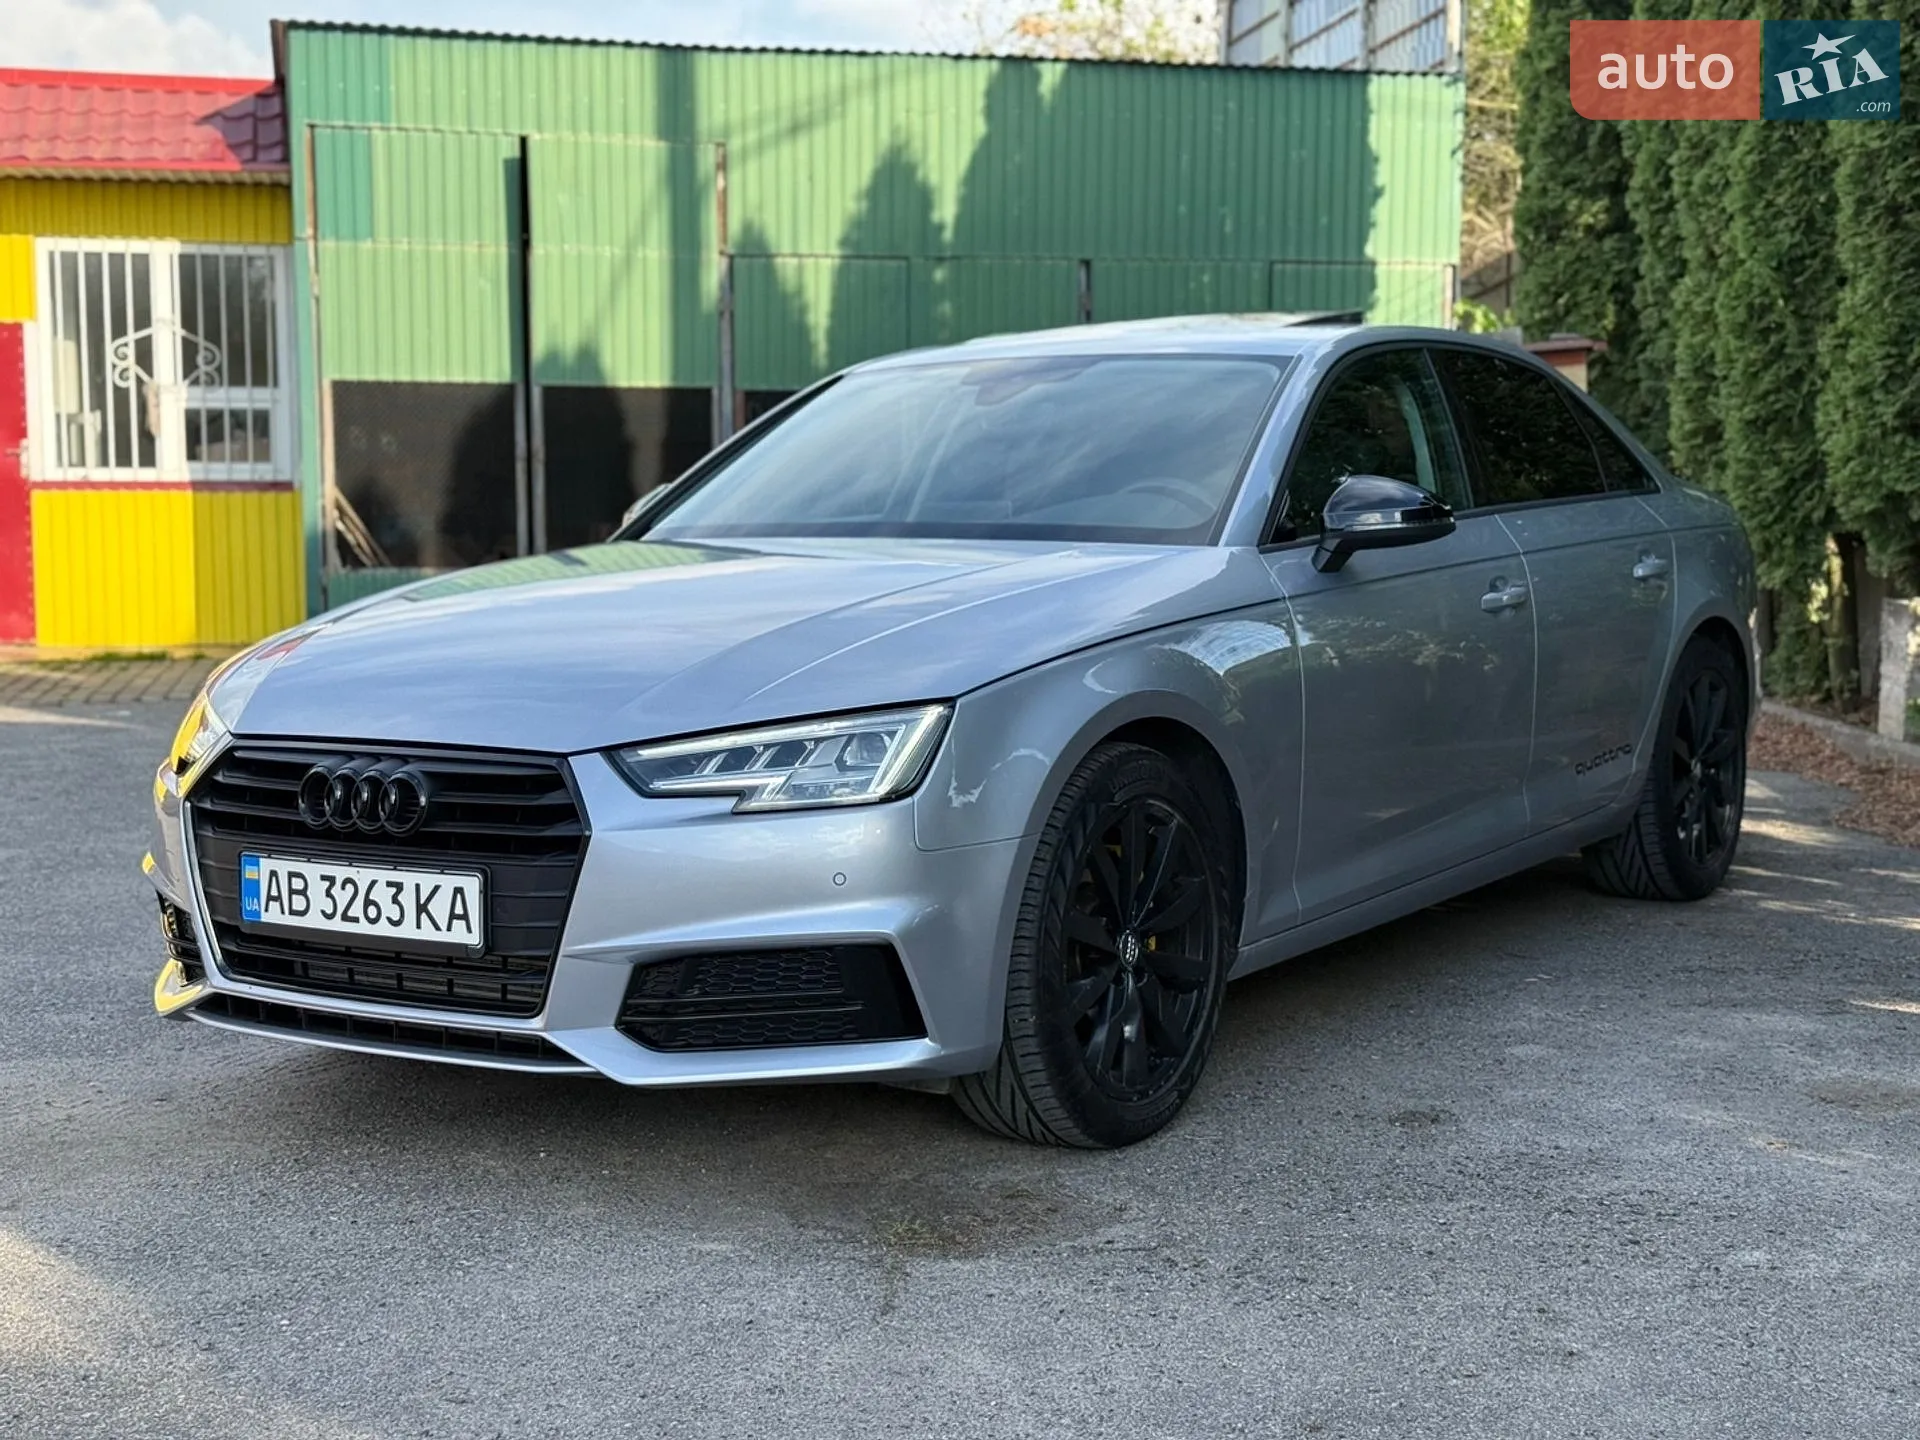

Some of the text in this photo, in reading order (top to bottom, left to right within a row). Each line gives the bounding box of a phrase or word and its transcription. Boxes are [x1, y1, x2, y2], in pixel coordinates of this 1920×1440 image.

[1574, 744, 1633, 777] quattro
[245, 896, 260, 912] UA
[264, 869, 473, 935] AB 3263 KA
